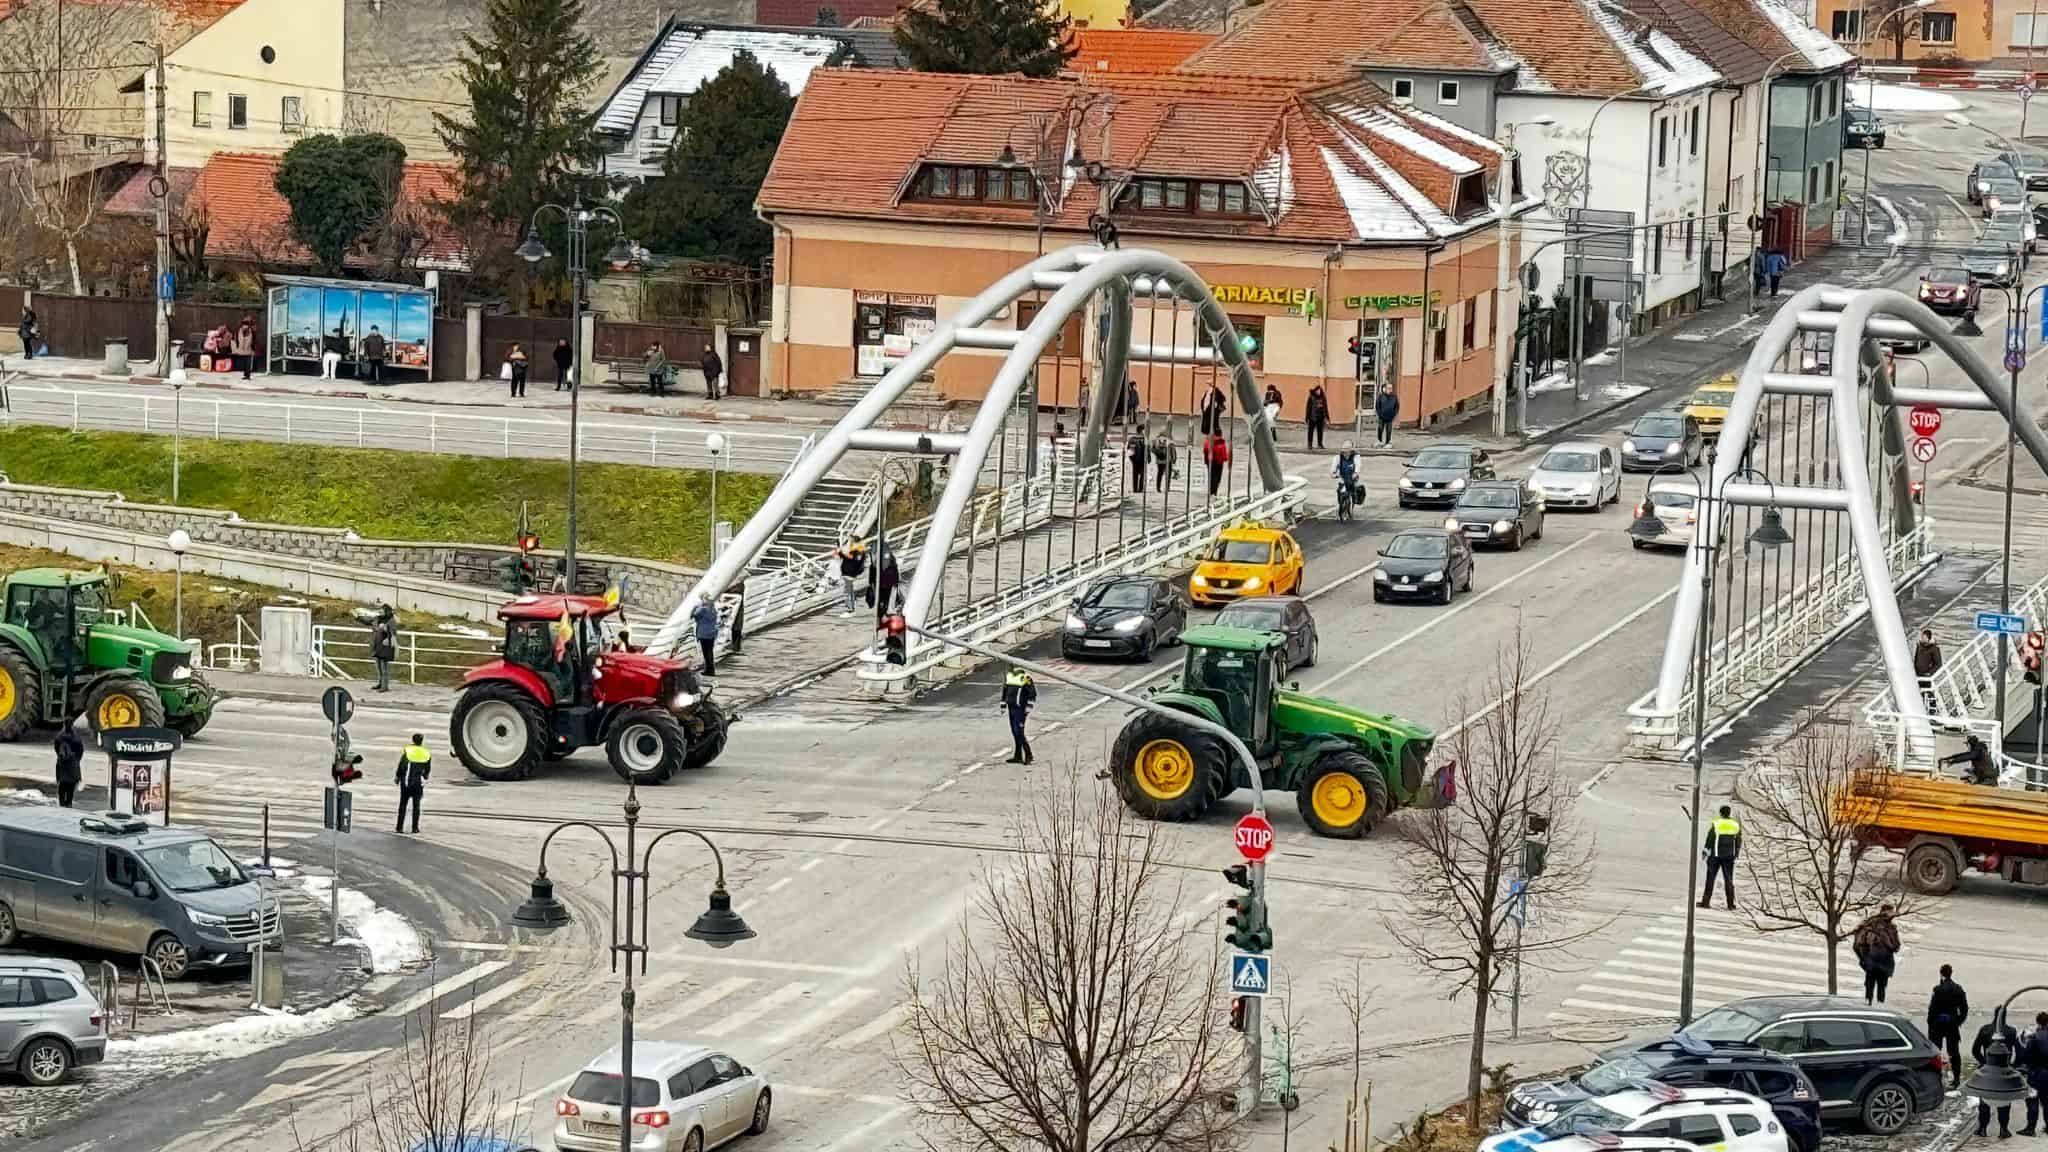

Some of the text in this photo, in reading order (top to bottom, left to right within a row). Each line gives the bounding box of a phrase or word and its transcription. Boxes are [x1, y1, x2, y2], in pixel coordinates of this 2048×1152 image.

[1206, 285, 1305, 304] ARMACIE
[1911, 412, 1940, 427] STOP
[1237, 827, 1272, 849] STOP
